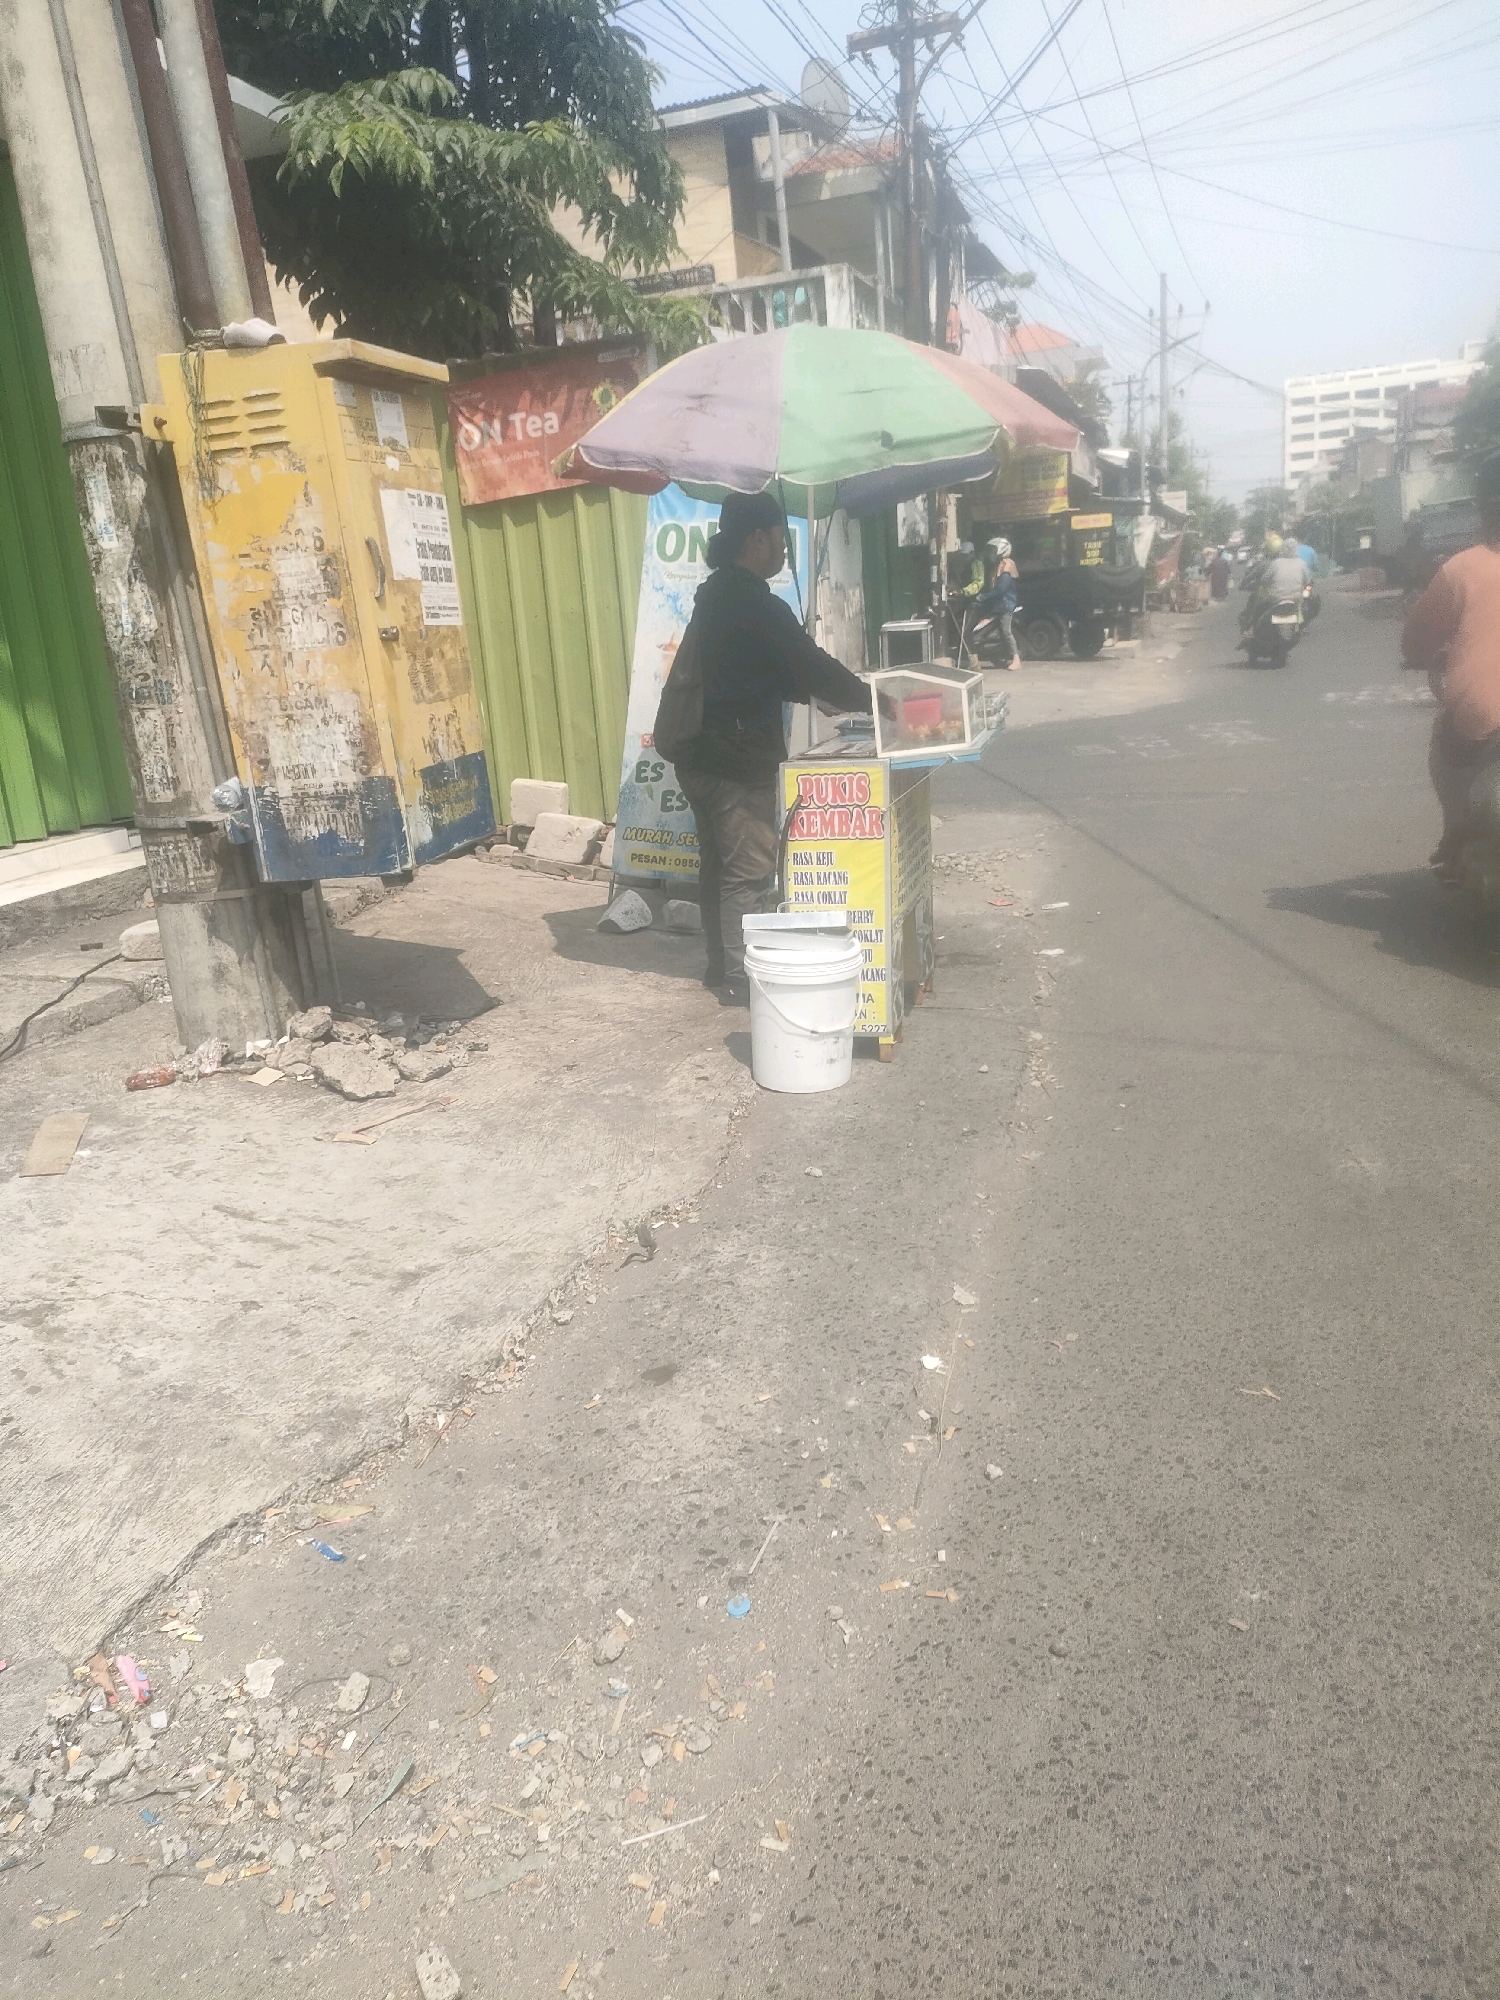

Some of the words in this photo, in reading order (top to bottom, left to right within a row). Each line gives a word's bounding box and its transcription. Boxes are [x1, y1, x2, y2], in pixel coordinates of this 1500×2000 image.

[458, 418, 503, 452] ON
[508, 411, 560, 441] Tea
[635, 760, 666, 784] ES
[797, 773, 870, 807] PUKIS
[660, 789, 689, 813] ES
[788, 807, 885, 841] KEMBAR
[623, 827, 674, 846] MURAH,
[630, 852, 667, 866] PESAN
[792, 851, 814, 866] RASA
[816, 851, 834, 867] KEJU
[793, 871, 815, 886] RASA
[816, 870, 849, 886] KACANG
[794, 891, 815, 904] RASA
[816, 890, 848, 905] COKLAT
